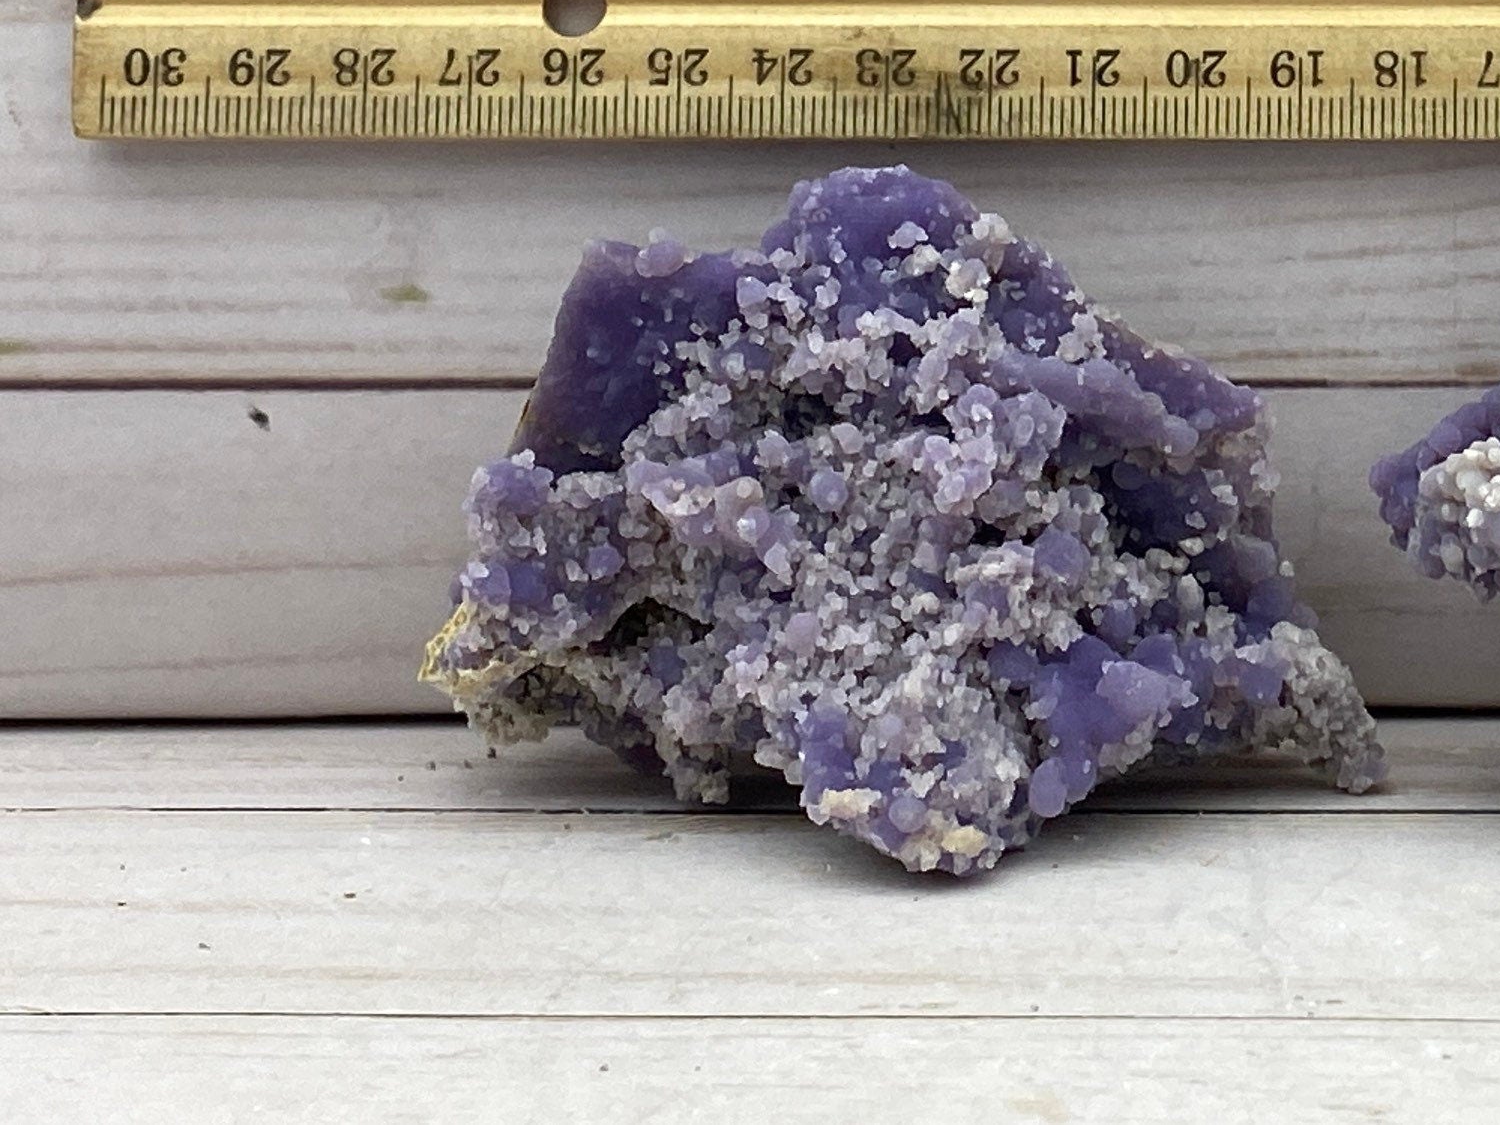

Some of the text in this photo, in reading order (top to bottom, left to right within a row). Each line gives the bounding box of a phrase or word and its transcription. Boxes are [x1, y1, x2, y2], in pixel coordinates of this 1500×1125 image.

[125, 48, 186, 87] 30
[228, 48, 291, 87] 29
[333, 49, 396, 88] 28
[440, 49, 501, 88] 27
[542, 49, 605, 88] 26
[647, 49, 709, 88] 25
[752, 49, 814, 88] 24
[855, 50, 917, 89] 23
[959, 50, 1020, 89] 22
[1067, 50, 1120, 89] 21
[1165, 50, 1226, 89] 20
[1270, 50, 1324, 89] 19
[1374, 51, 1427, 90] 18
